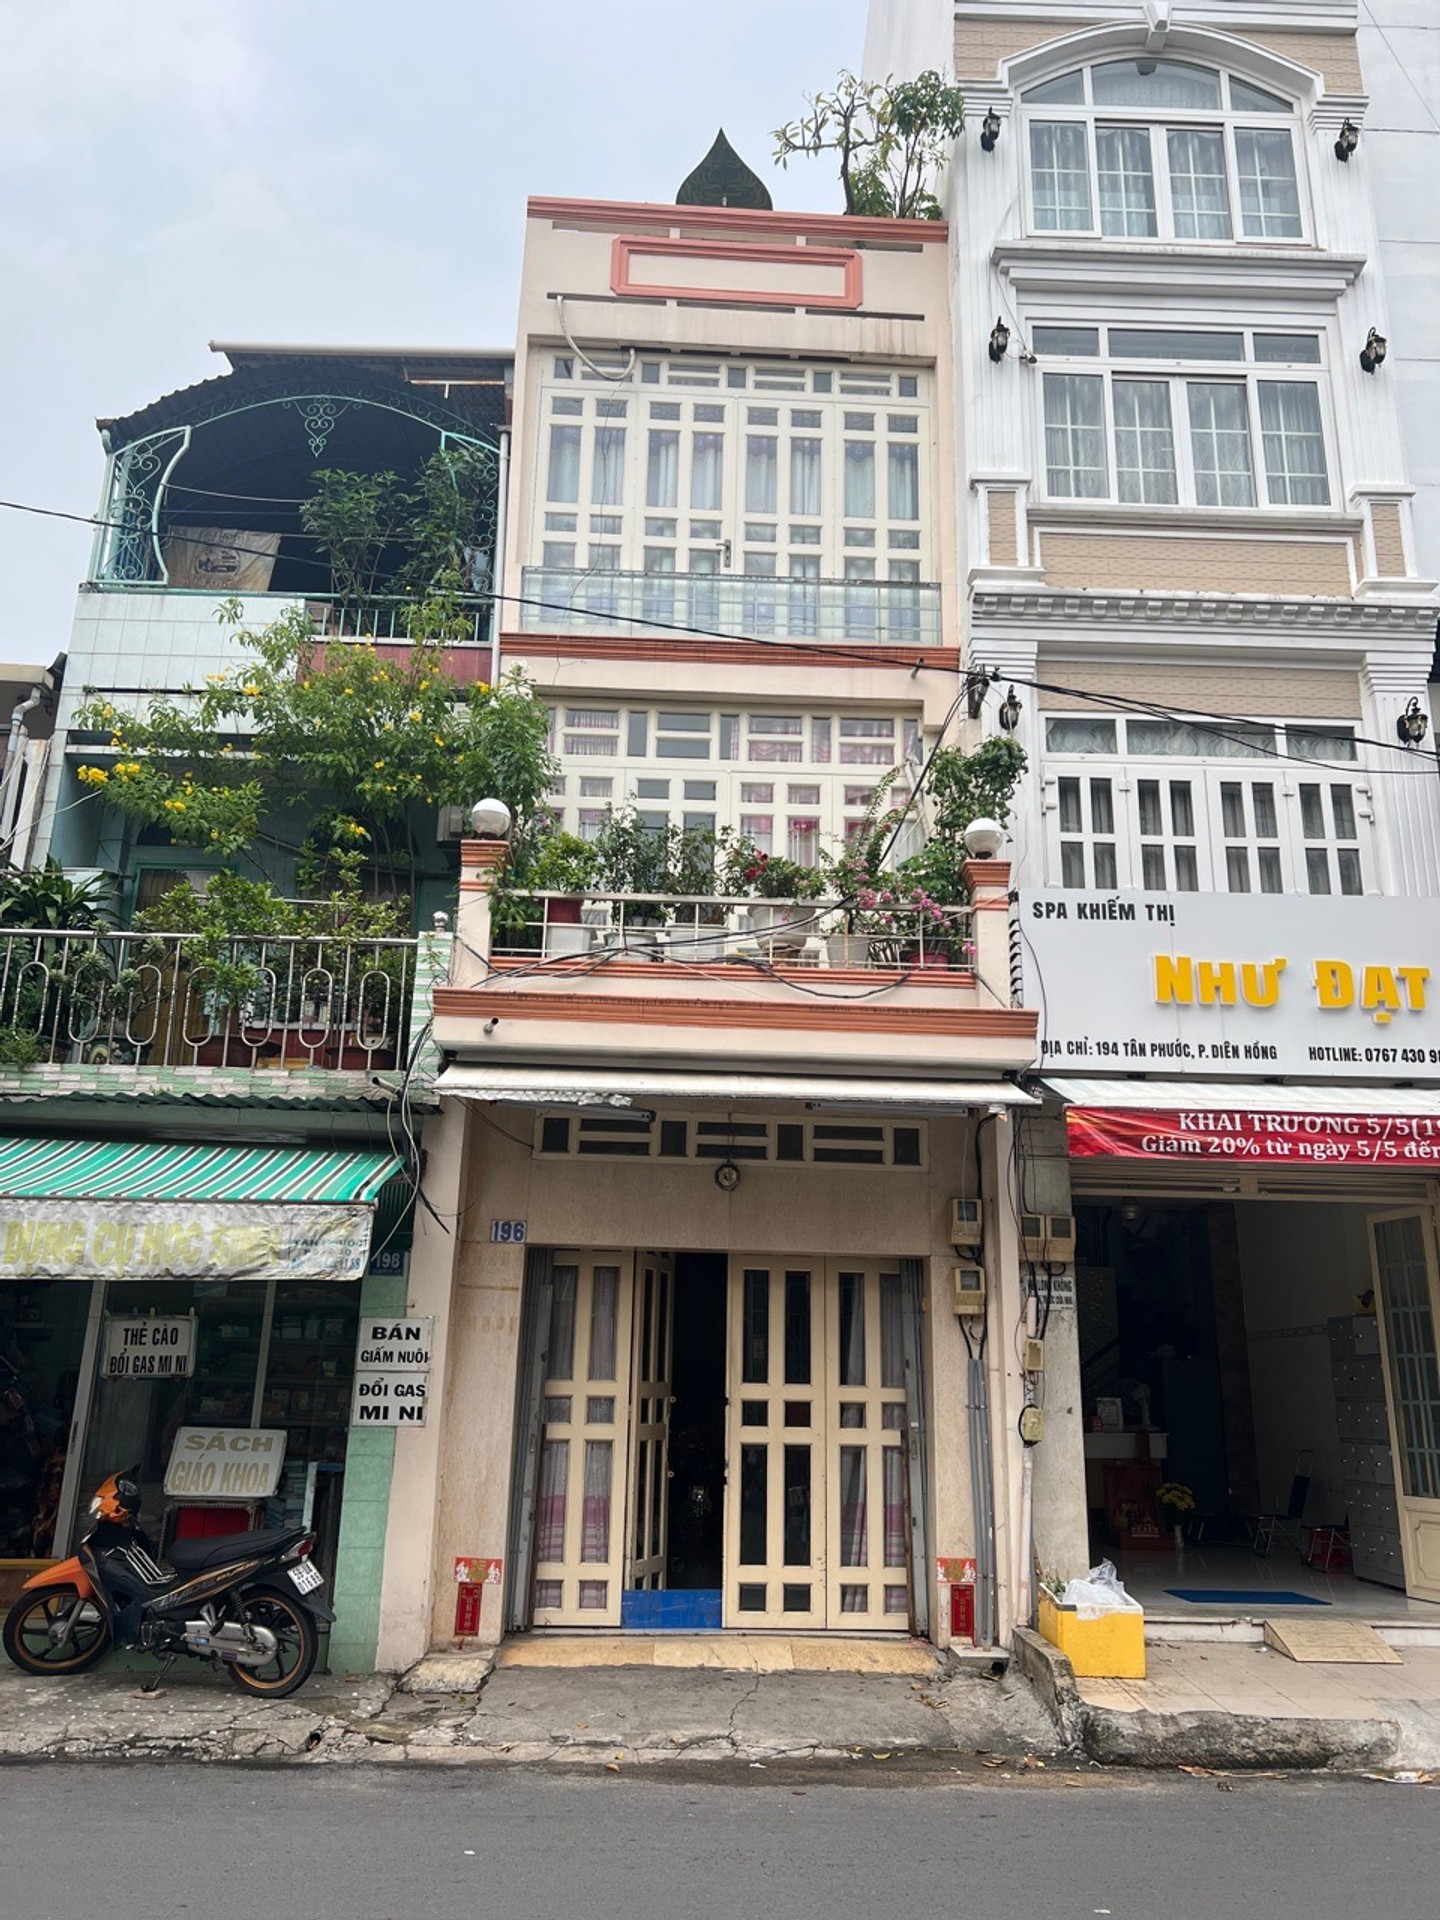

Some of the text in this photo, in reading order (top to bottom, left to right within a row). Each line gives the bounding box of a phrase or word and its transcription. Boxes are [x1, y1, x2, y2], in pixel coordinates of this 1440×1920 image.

[1033, 896, 1176, 927] SPA KHIẾM THỊ
[1153, 955, 1431, 1024] NHƯ ĐẠT
[1067, 1036, 1093, 1056] CHỈ:
[1096, 1041, 1119, 1056] 194
[1123, 1038, 1147, 1057] TÂN
[1150, 1038, 1195, 1059] PHƯỚC,
[1308, 1046, 1363, 1062] HOTLINE:
[1365, 1047, 1398, 1063] 0767
[1401, 1048, 1426, 1063] 430
[1179, 1112, 1440, 1140] KHAI TRƯƠNG 5/5(1
[1208, 1136, 1260, 1155] 20%
[1266, 1137, 1292, 1155] từ
[1298, 1138, 1350, 1160] ngày
[1357, 1140, 1398, 1161] 5/5
[494, 1221, 525, 1242] 196
[376, 1252, 400, 1268] 198
[123, 1322, 178, 1346] THẺ CÀO
[372, 1323, 421, 1340] BÁN
[109, 1348, 187, 1374] ĐỔI GAS MI NI
[361, 1346, 428, 1363] GIẤM NUÔI
[359, 1377, 426, 1397] ĐỔI GAS
[359, 1405, 423, 1420] MI NI
[184, 1431, 274, 1452] SÁCH
[170, 1454, 270, 1493] GIÁO KHOA
